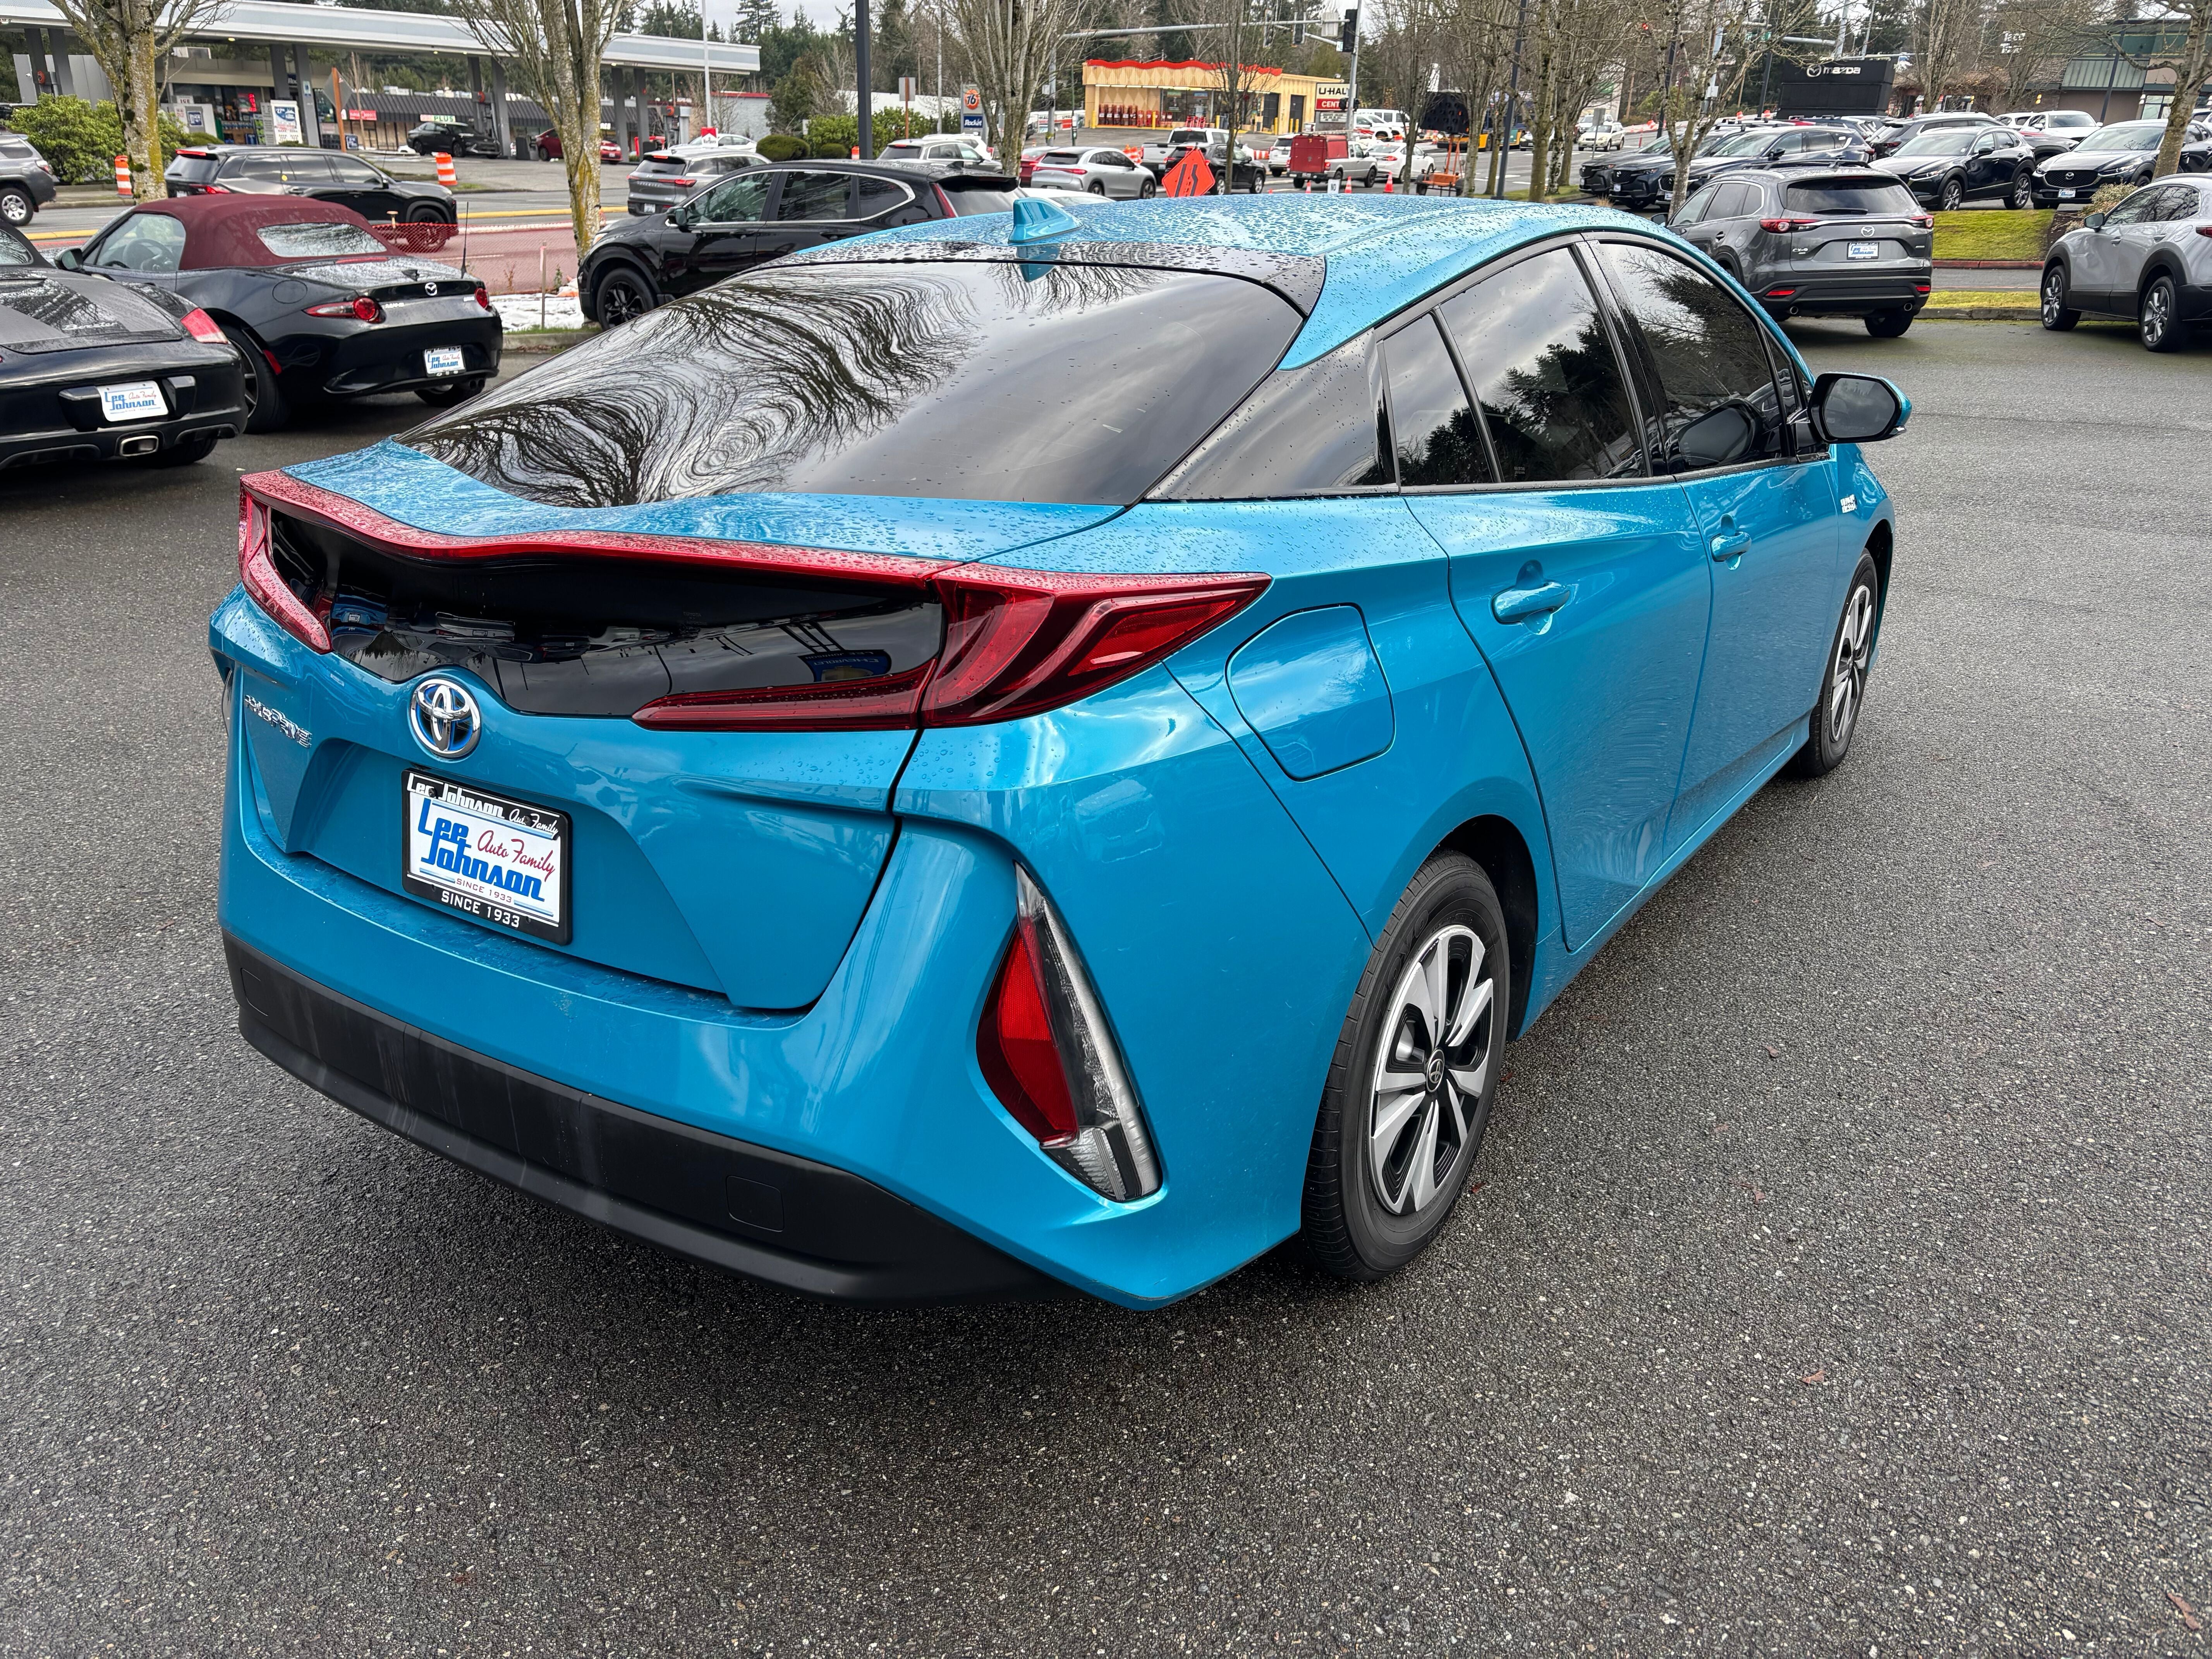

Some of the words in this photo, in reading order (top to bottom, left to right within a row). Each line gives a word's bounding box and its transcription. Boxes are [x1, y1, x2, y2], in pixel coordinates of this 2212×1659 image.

[966, 93, 976, 105] 76
[428, 354, 440, 363] Lee
[104, 392, 125, 402] Lee
[109, 399, 156, 410] Johnson
[438, 783, 505, 819] Johnson
[509, 808, 527, 825] Aut
[530, 813, 559, 839] Family
[418, 798, 470, 842] Lee
[477, 830, 509, 857] Auto
[511, 839, 556, 882] Family
[421, 841, 545, 902] Johnson
[456, 878, 484, 893] SINCE
[489, 889, 512, 903] 1933
[441, 890, 481, 914] SINCE
[487, 905, 520, 928] 1933
